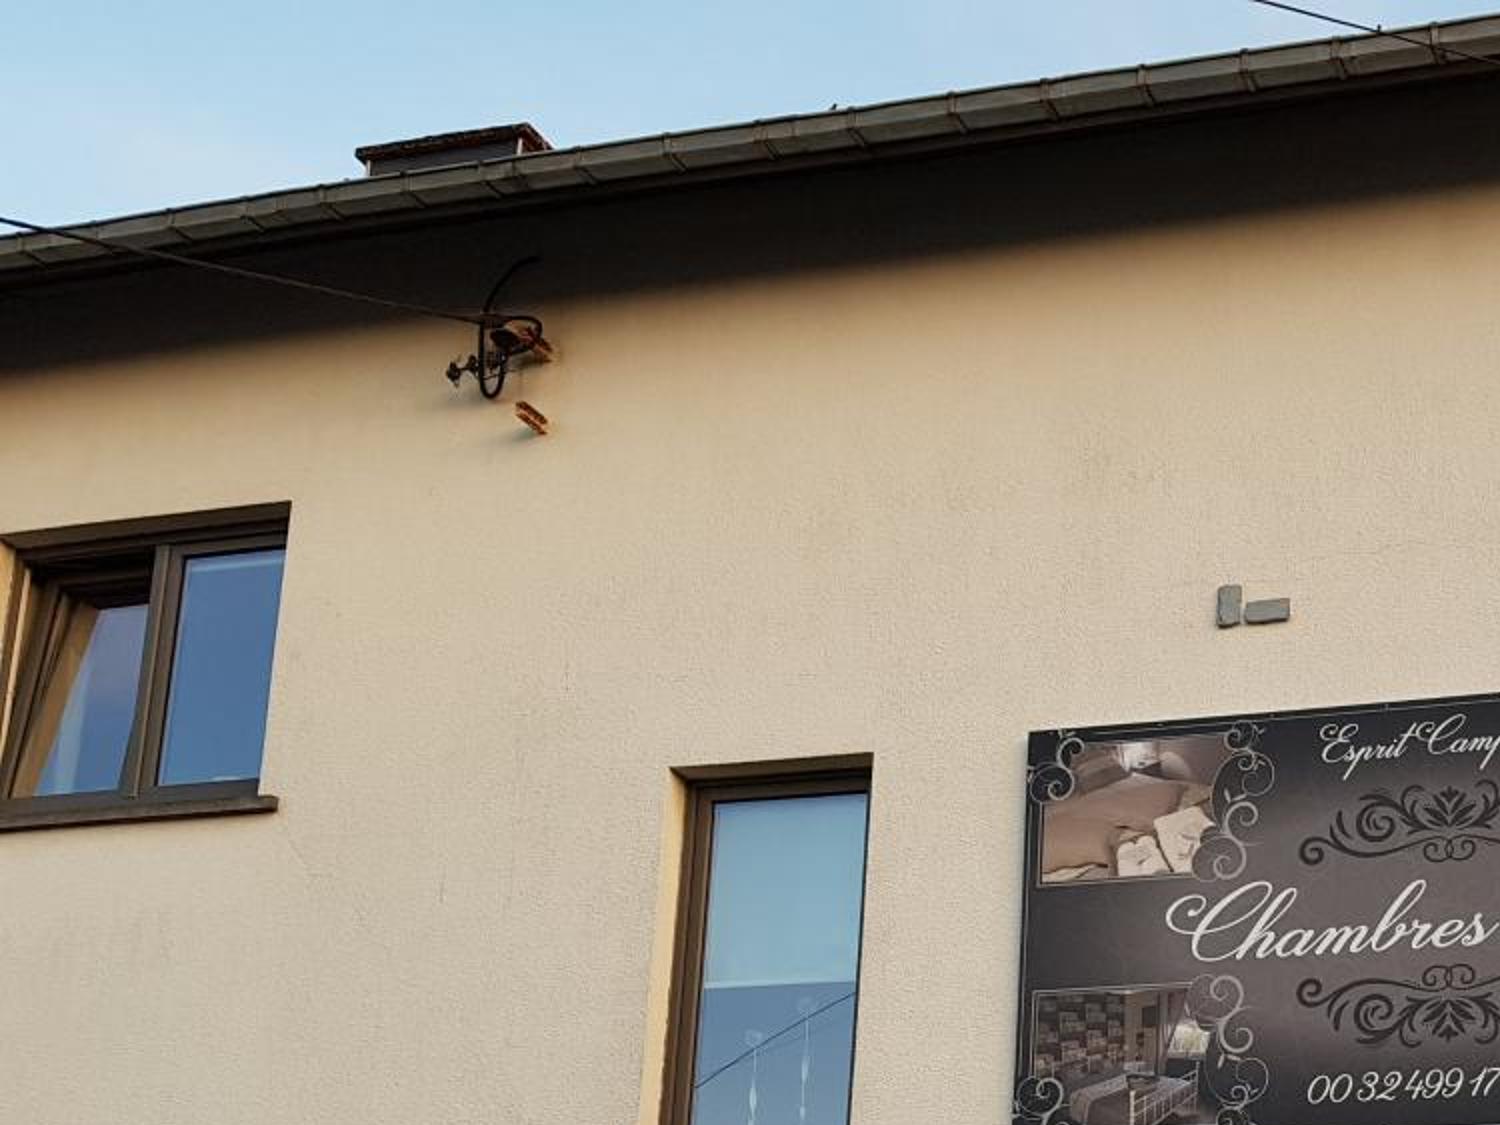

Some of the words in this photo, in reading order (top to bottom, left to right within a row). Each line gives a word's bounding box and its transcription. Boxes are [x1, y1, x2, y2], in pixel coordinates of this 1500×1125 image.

[1319, 722, 1417, 782] Esprit
[1165, 879, 1500, 962] Chambres
[1306, 1073, 1353, 1105] 00
[1356, 1071, 1403, 1102] 32
[1404, 1067, 1464, 1100] 499
